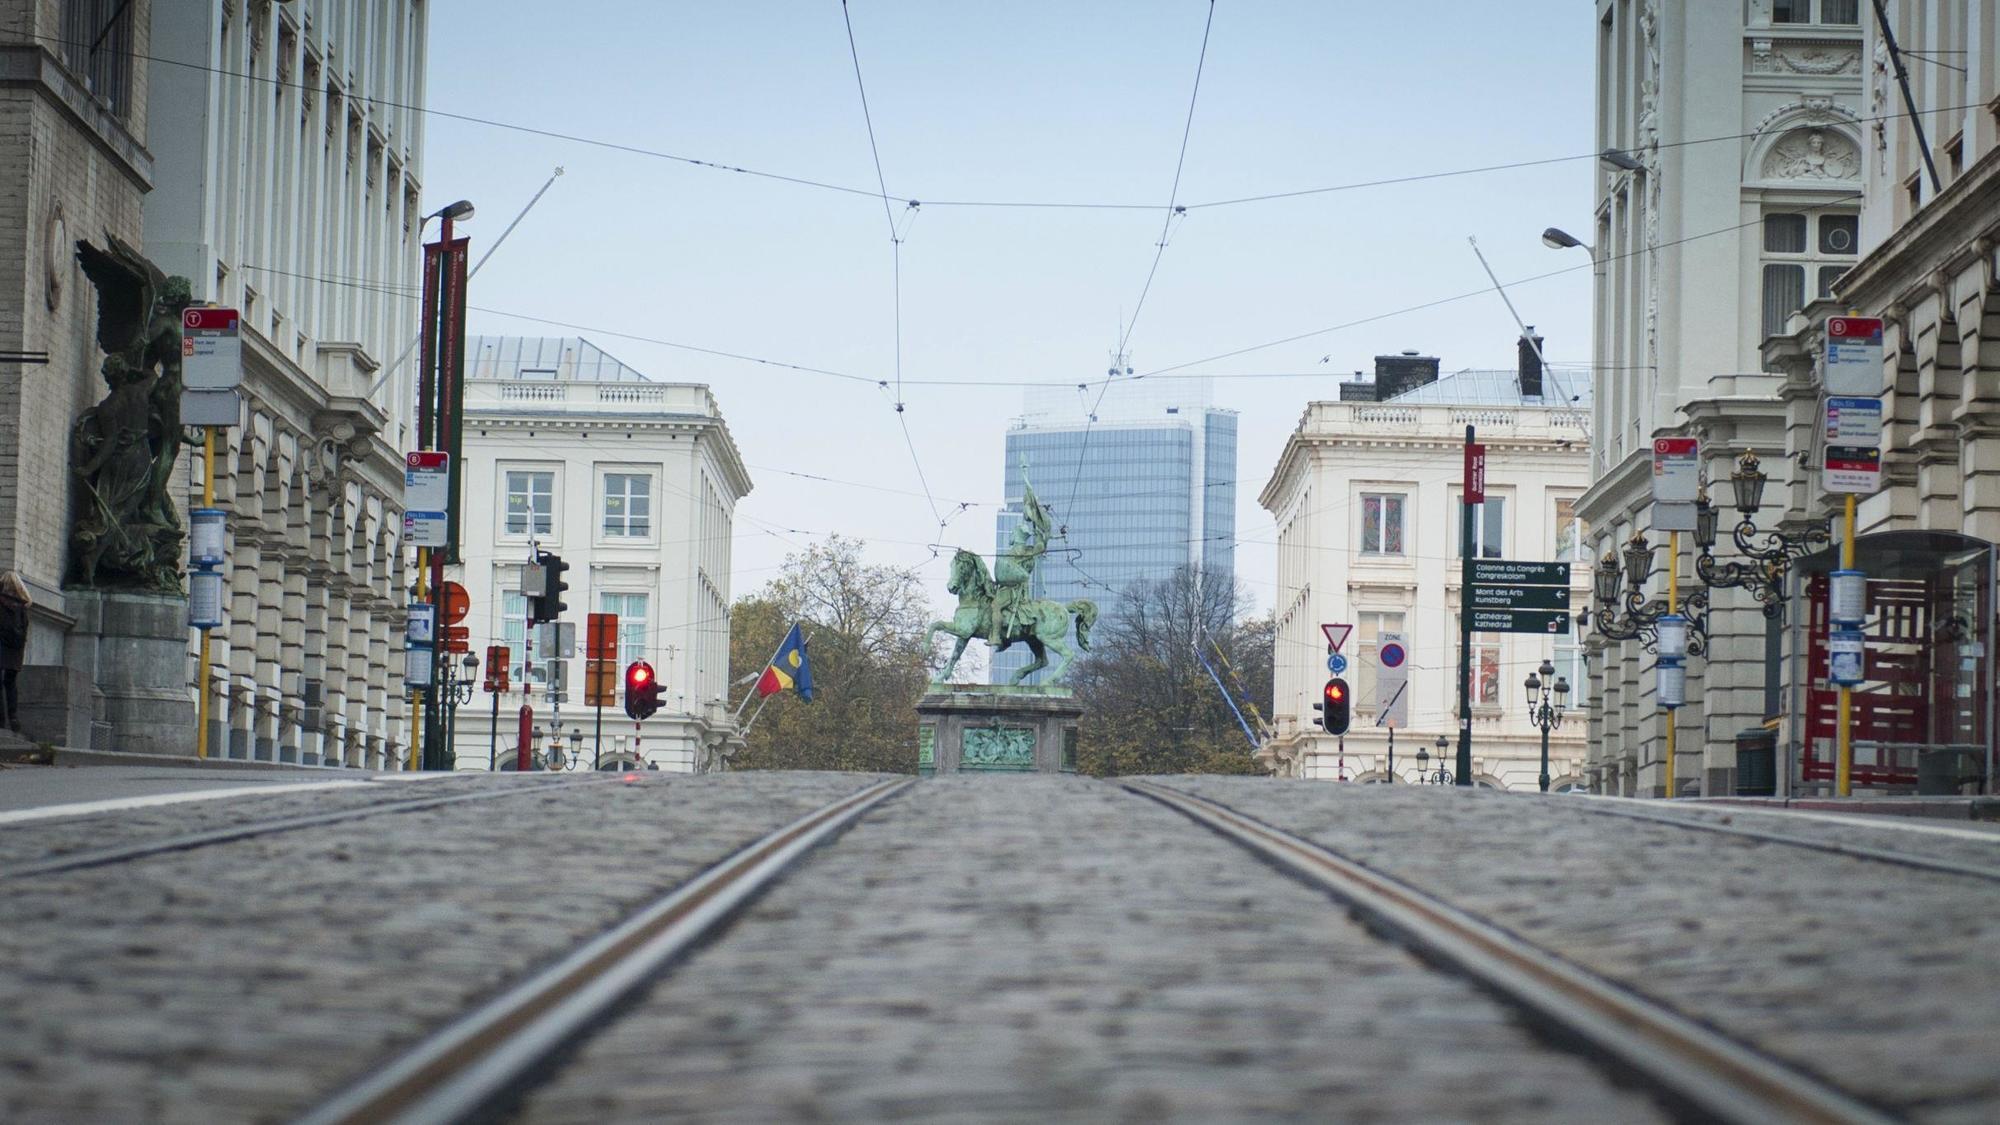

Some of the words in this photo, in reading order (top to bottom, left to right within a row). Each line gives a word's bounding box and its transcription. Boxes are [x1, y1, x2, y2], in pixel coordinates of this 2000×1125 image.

[1476, 564, 1505, 572] Colonne
[1506, 564, 1516, 572] du
[1516, 565, 1546, 573] Congrès
[1476, 572, 1526, 580] Congreskolom
[1475, 597, 1512, 605] Kunstberg
[1474, 612, 1513, 620] Cathédrale
[1474, 620, 1513, 628] Kathedraal
